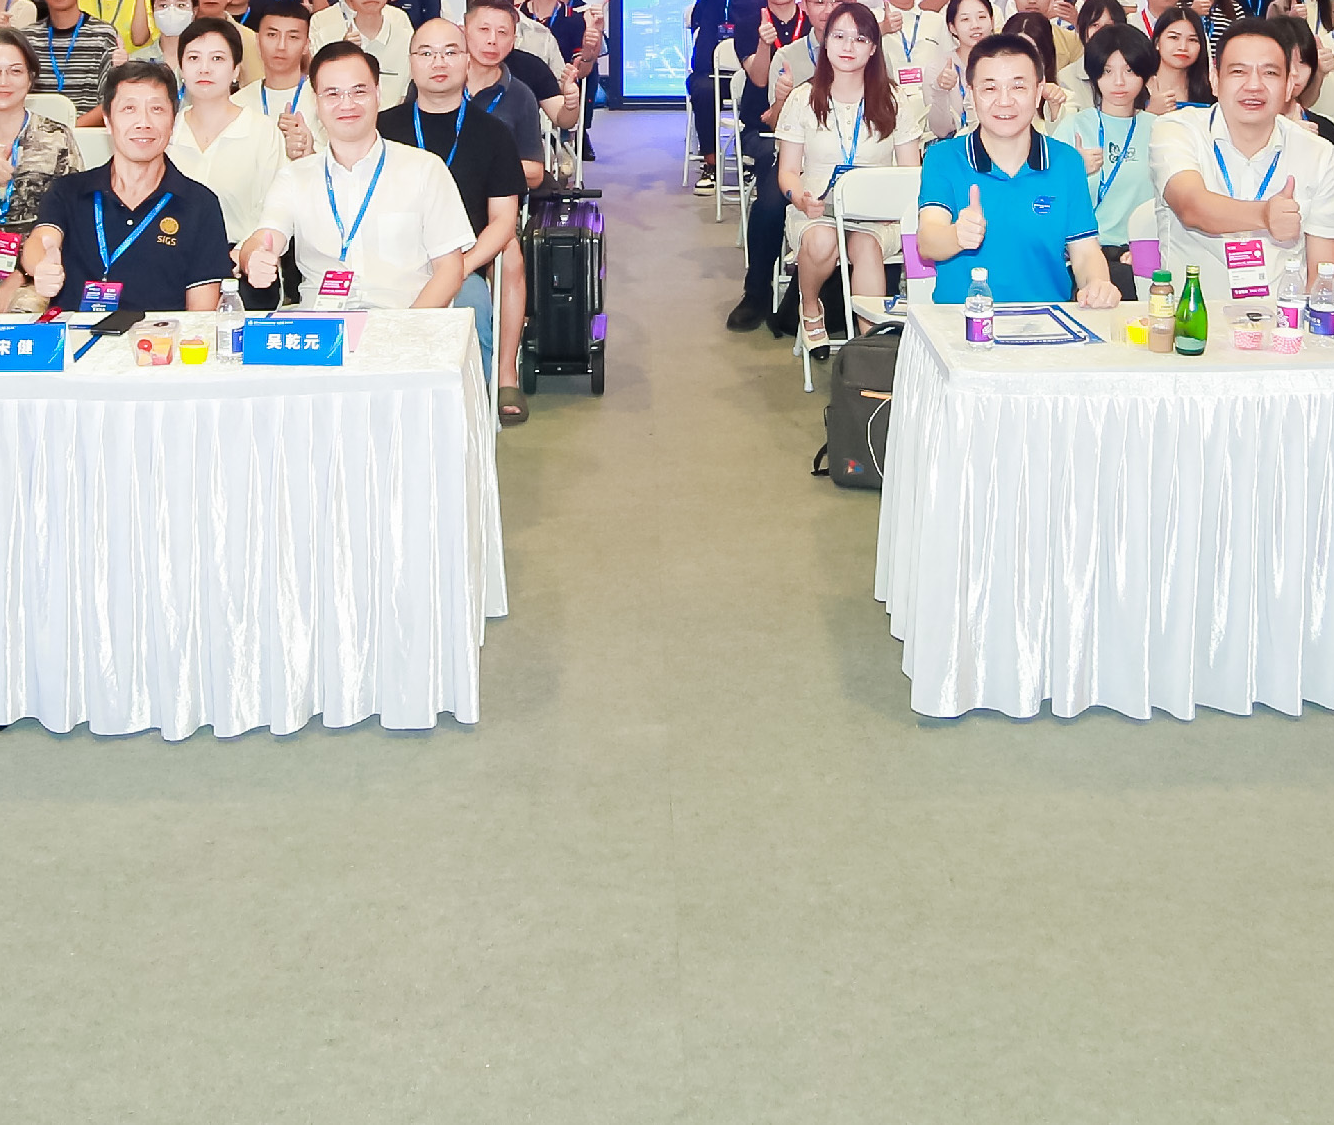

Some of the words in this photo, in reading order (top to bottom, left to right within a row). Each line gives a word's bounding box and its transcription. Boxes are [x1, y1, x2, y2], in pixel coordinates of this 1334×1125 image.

[157, 235, 177, 246] SIGS
[266, 332, 321, 350] 吴乾元
